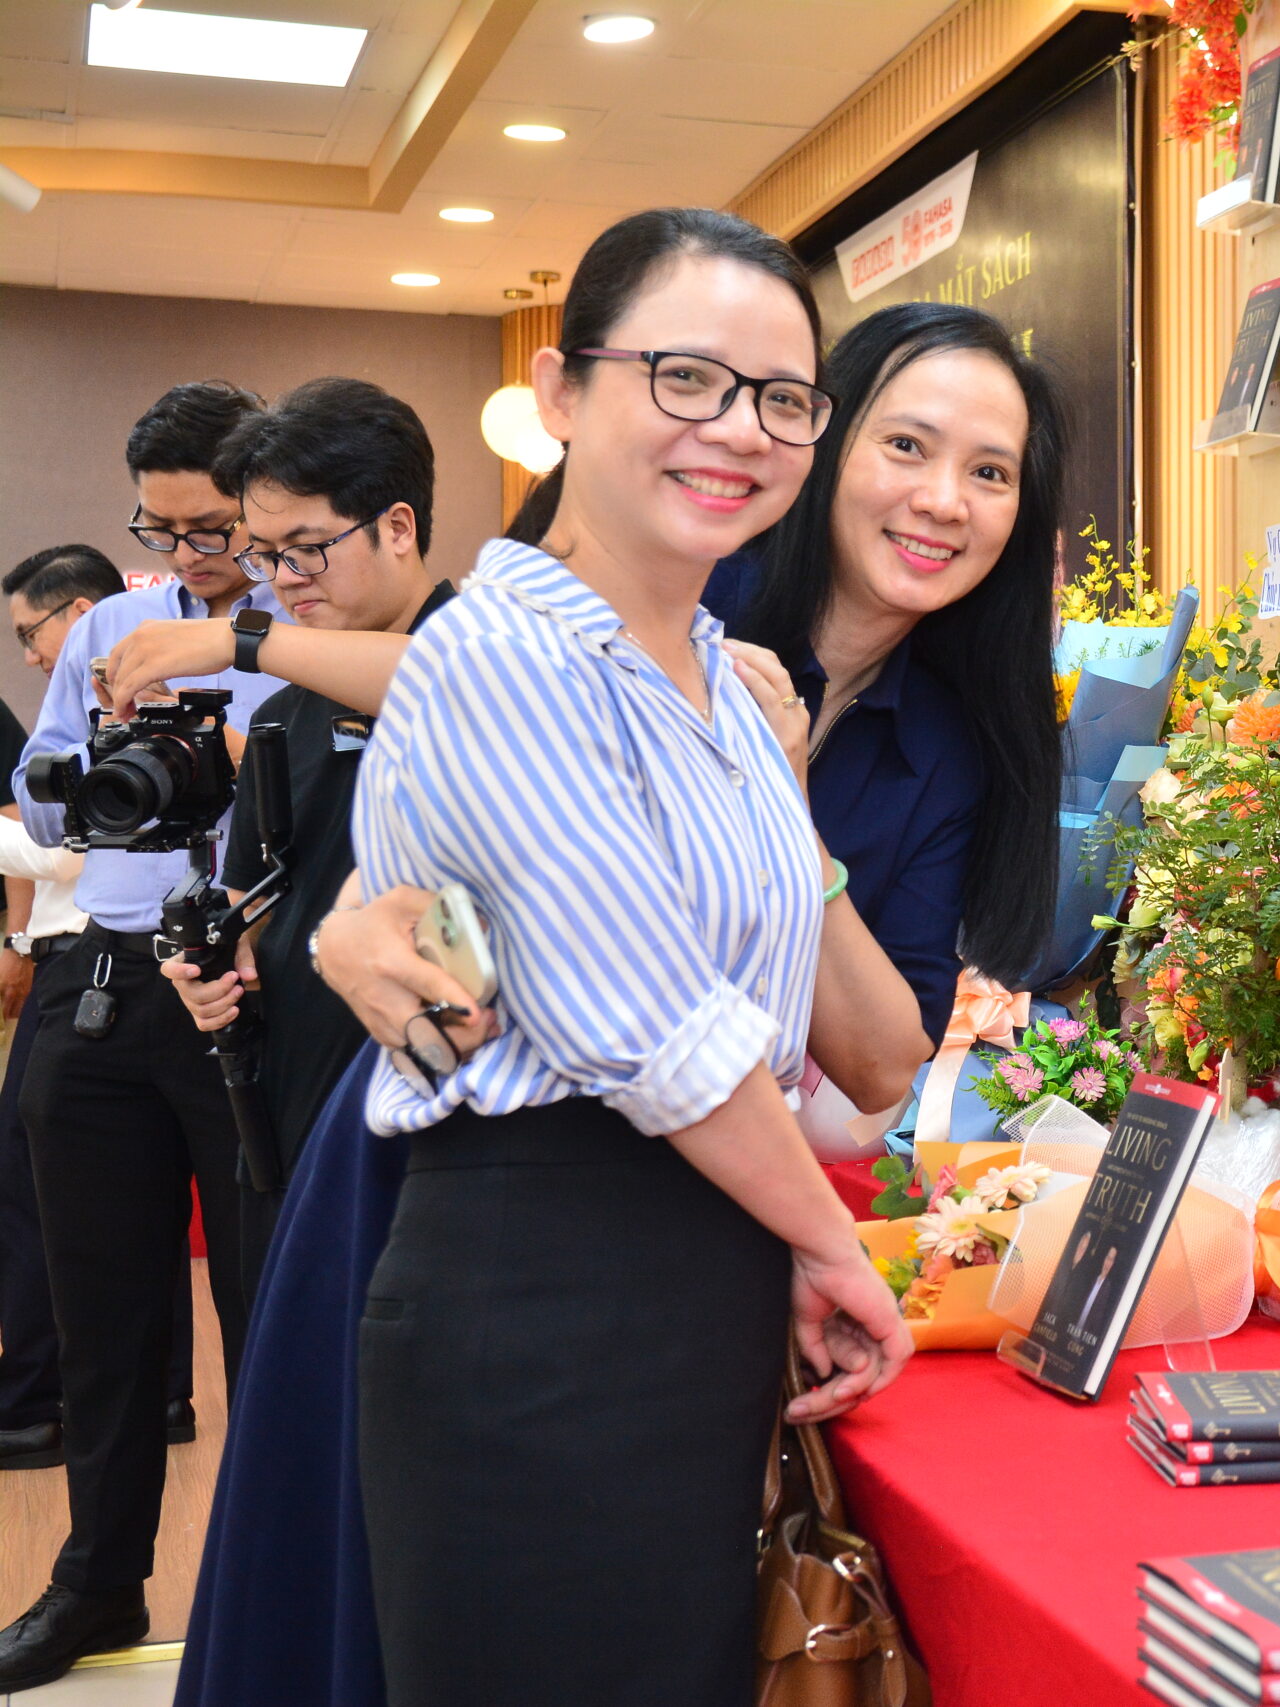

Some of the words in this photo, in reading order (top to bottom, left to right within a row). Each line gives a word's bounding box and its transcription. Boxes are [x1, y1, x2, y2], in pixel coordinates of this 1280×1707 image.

[981, 231, 1032, 300] SÁCH
[1105, 1123, 1174, 1172] LIVING
[1087, 1172, 1153, 1224] TRUTH
